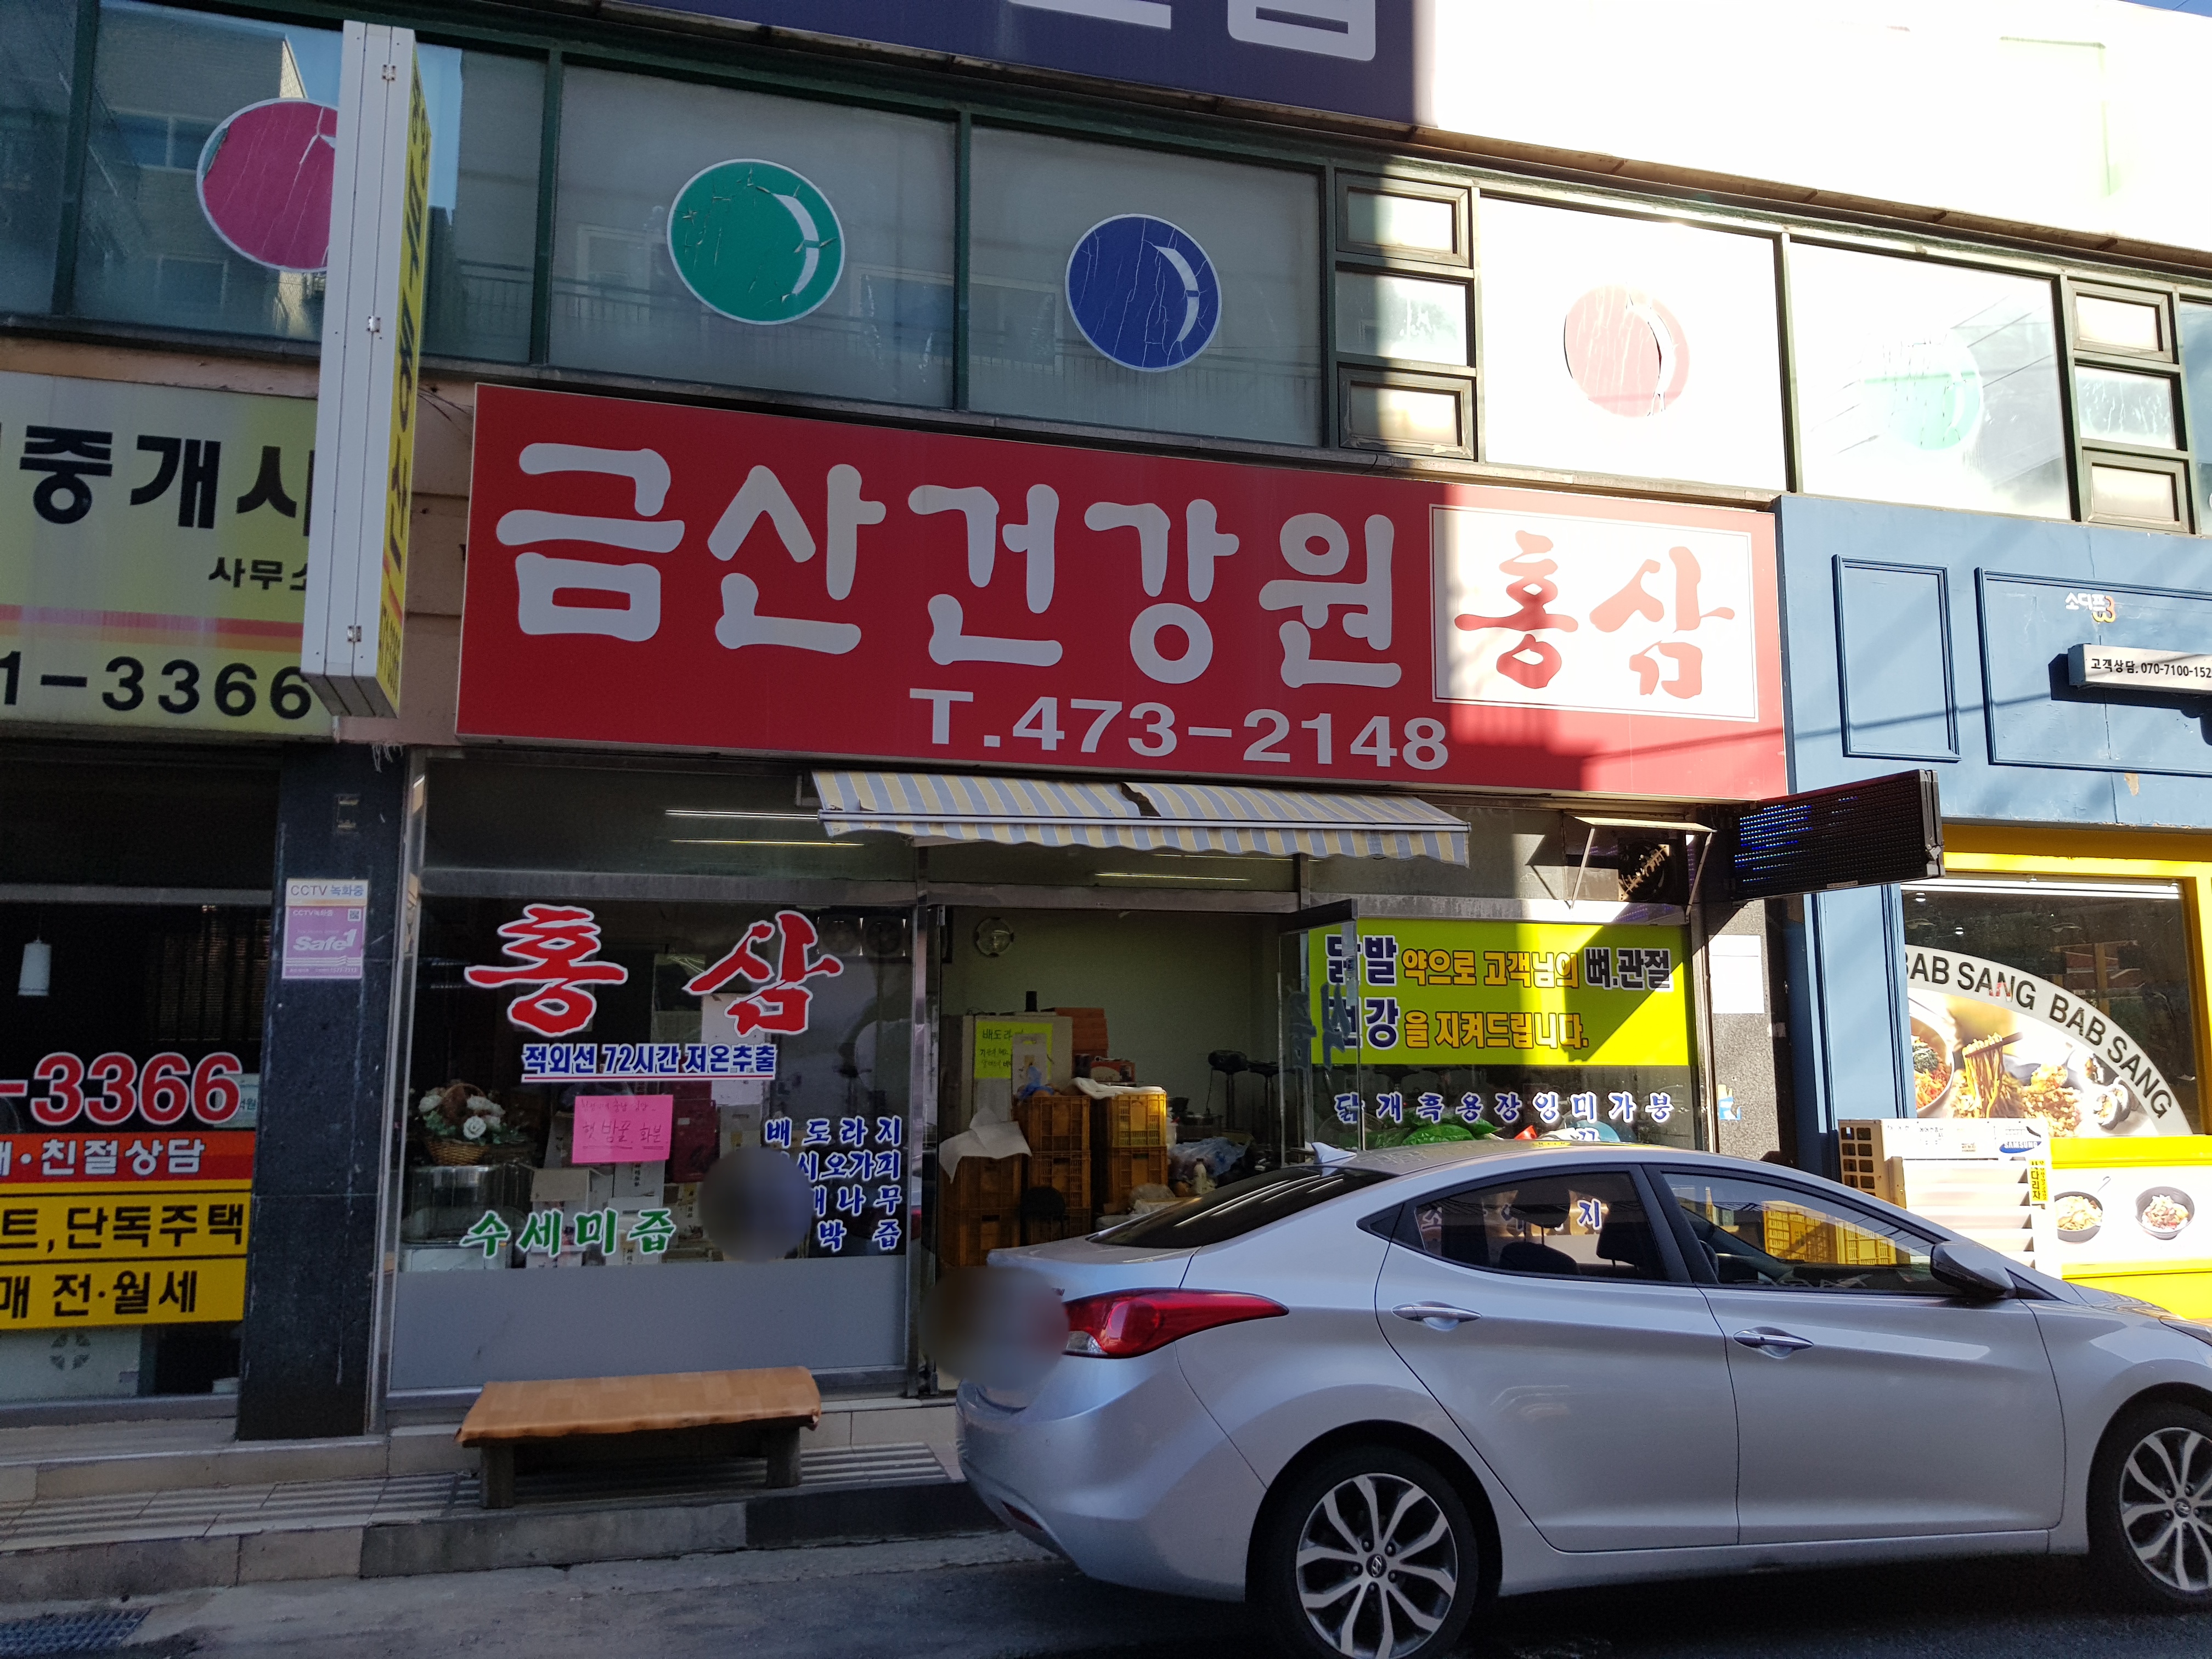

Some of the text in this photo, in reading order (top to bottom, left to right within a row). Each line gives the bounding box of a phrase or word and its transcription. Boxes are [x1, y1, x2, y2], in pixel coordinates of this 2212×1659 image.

[496, 442, 1402, 689] 금산건강원
[1454, 530, 1735, 699] 홍삼
[290, 885, 364, 896] CCTV 녹화중
[465, 903, 844, 1037] 홍삼
[1483, 951, 1579, 988] 고객님의
[522, 1043, 777, 1074] 적외선 72시간 저온추출
[1957, 962, 2037, 1010] SANG
[2049, 993, 2107, 1046] BAB
[2108, 1036, 2172, 1119] SANG
[765, 1115, 902, 1148] 배도라지
[781, 1149, 901, 1183] 시오가피
[460, 1207, 676, 1258] 수세미즙
